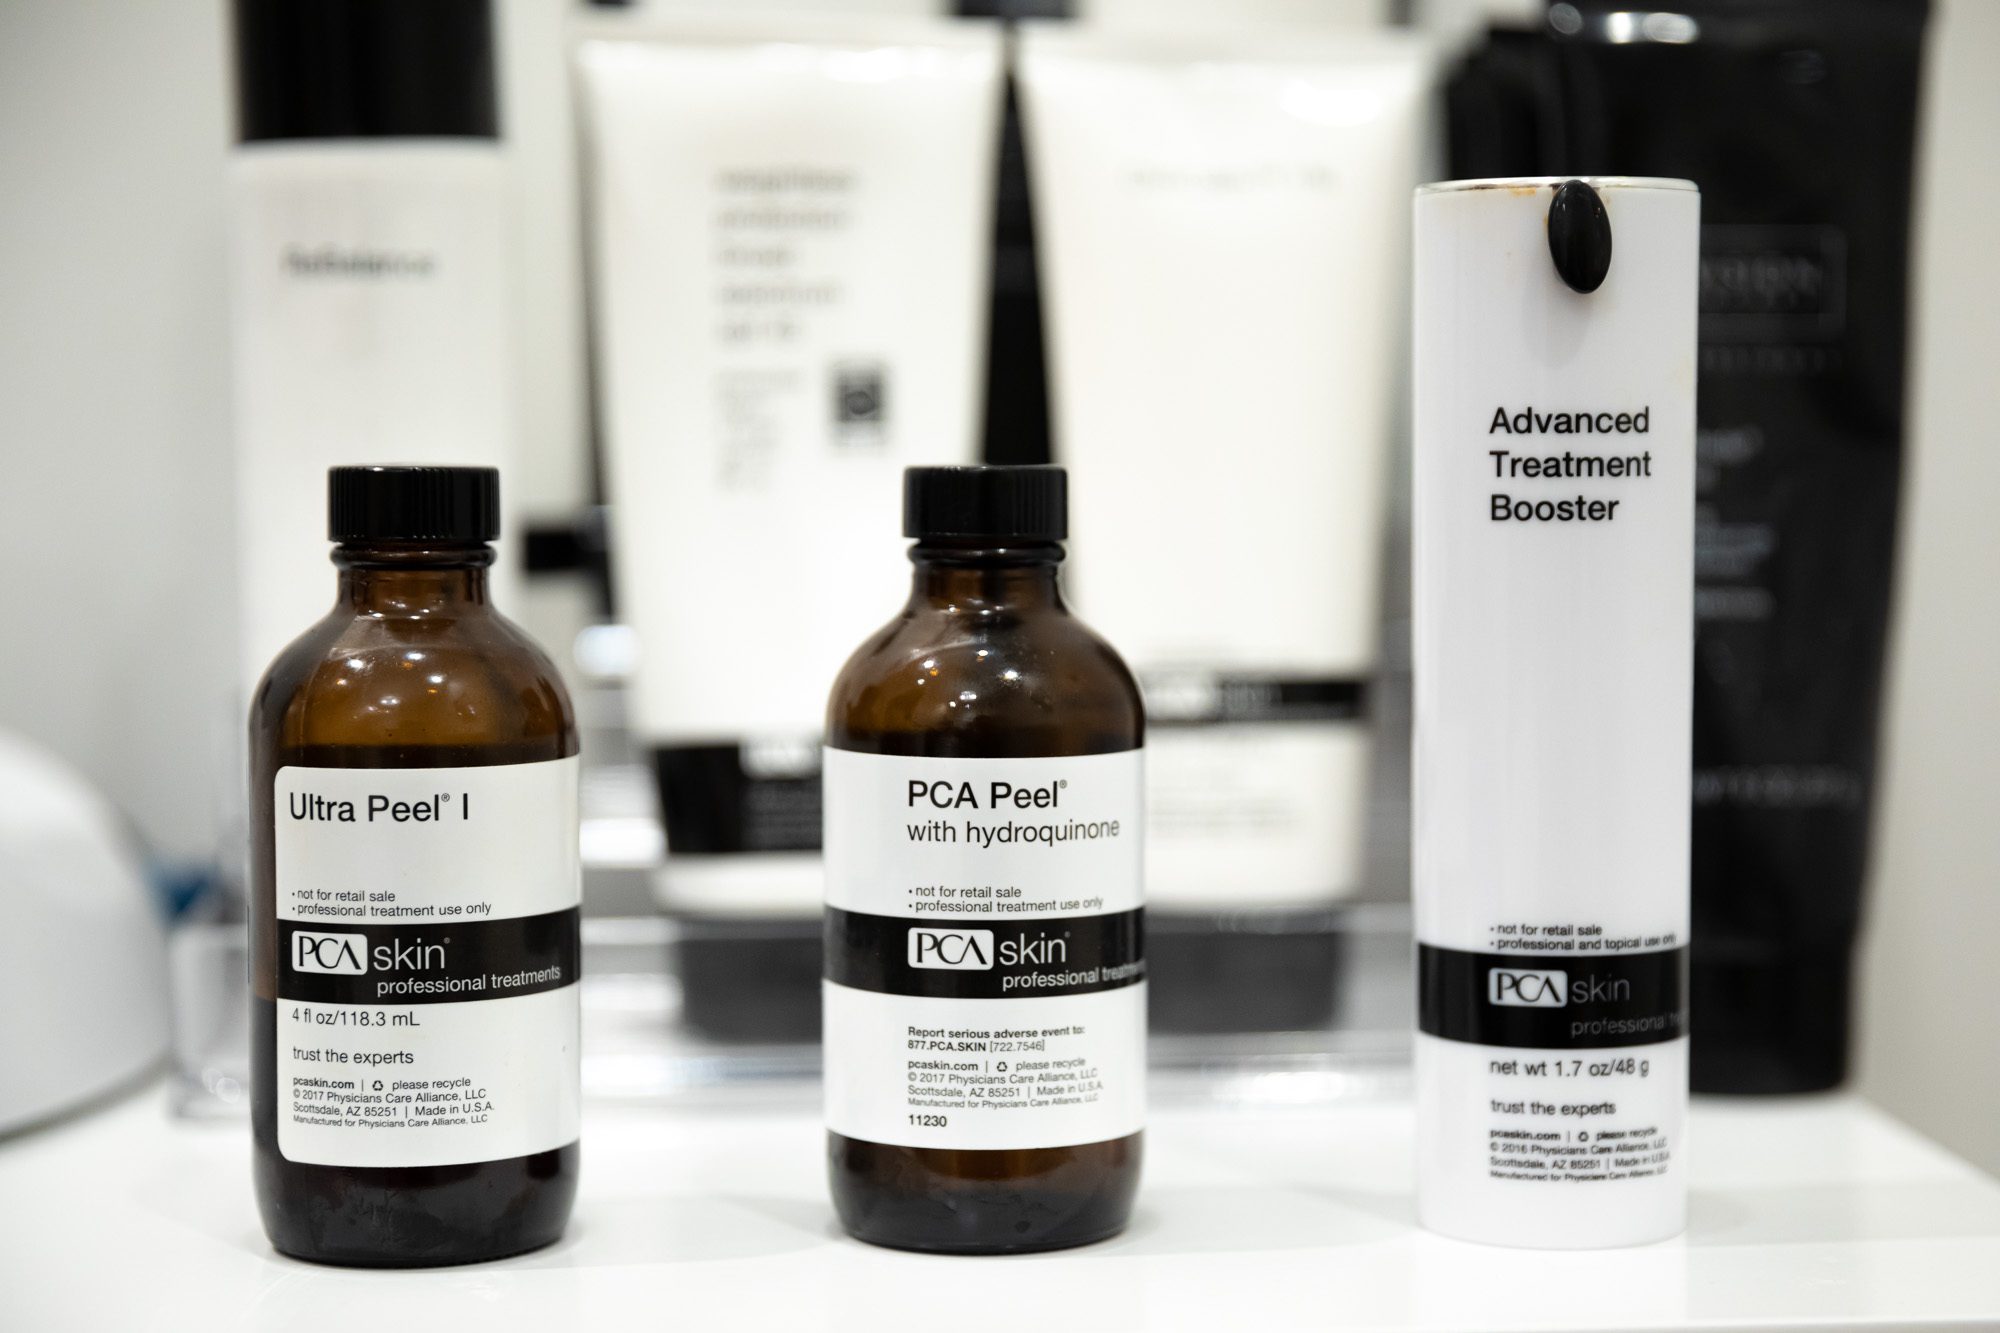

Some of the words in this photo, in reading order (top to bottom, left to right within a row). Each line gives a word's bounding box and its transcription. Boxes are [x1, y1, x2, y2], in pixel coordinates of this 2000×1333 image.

[1489, 406, 1650, 434] Advanced
[1489, 450, 1651, 478] Treatment
[1491, 494, 1619, 521] Booster
[908, 780, 978, 809] PCA
[290, 792, 355, 822] Ultra
[908, 820, 956, 842] with
[966, 819, 1120, 848] hydroquinone
[297, 889, 314, 901] not
[317, 889, 331, 901] for
[335, 890, 365, 902] retail
[370, 890, 396, 903] sale
[915, 886, 935, 897] not
[939, 886, 955, 897] for
[960, 886, 991, 898] retail
[996, 886, 1021, 898] sale
[297, 904, 366, 918] professional
[371, 904, 434, 917] treatment
[439, 904, 462, 916] use
[466, 902, 492, 916] only
[915, 900, 992, 913] professional
[997, 900, 1056, 913] treatment
[1060, 900, 1079, 910] use
[1083, 896, 1103, 911] only
[1497, 925, 1517, 935] not
[1521, 924, 1538, 935] for
[1542, 925, 1574, 936] retail
[1578, 925, 1602, 936] sale
[916, 932, 987, 965] PCA
[1497, 938, 1574, 951] professional
[1579, 938, 1601, 950] and
[1606, 936, 1641, 951] topical
[1645, 936, 1660, 947] use
[299, 936, 361, 970] PCA
[377, 974, 486, 997] professional
[492, 966, 560, 989] treatments
[1002, 967, 1099, 991] professional
[1497, 973, 1562, 1003] PCA
[1572, 974, 1630, 1004] skin
[292, 1008, 299, 1022] 4
[304, 1009, 311, 1023] fl
[316, 1010, 386, 1027] oz/118.3
[392, 1012, 420, 1026] mL
[1571, 1013, 1666, 1039] professional
[908, 1027, 944, 1039] Report
[948, 1028, 990, 1039] serious
[994, 1028, 1038, 1039] adverse
[1041, 1026, 1069, 1037] event
[908, 1040, 986, 1052] 877.PCA.SKIN
[990, 1039, 1044, 1052] [722.7546]
[293, 1046, 321, 1062] trust
[326, 1048, 348, 1064] the
[354, 1050, 414, 1067] experts
[908, 1060, 978, 1070] pcaskin.com
[1016, 1061, 1049, 1072] please
[1053, 1058, 1085, 1069] recycle
[1490, 1060, 1518, 1075] net
[1524, 1061, 1546, 1076] wt
[1555, 1061, 1582, 1076] 1.7
[1590, 1058, 1634, 1076] oz/48
[1641, 1060, 1649, 1077] g
[293, 1077, 354, 1090] pcaskin.com
[392, 1080, 428, 1091] please
[432, 1077, 471, 1090] recycle
[920, 1073, 944, 1083] 2017
[949, 1074, 1006, 1086] Physicians
[1009, 1074, 1034, 1083] Care
[1080, 1068, 1098, 1079] LLC
[303, 1090, 324, 1100] 2017
[327, 1092, 382, 1104] Physicians
[385, 1093, 412, 1103] Care
[415, 1092, 462, 1102] Alliance,
[465, 1088, 486, 1099] LLC
[908, 1085, 965, 1097] Scottsdale,
[969, 1088, 984, 1097] AZ
[988, 1087, 1020, 1097] 85251
[1037, 1086, 1065, 1096] Made
[1068, 1084, 1075, 1093] in
[293, 1101, 342, 1116] Scottsdale,
[346, 1106, 360, 1116] AZ
[364, 1106, 396, 1116] 85251
[415, 1106, 446, 1116] Made
[450, 1105, 458, 1113] in
[908, 1098, 964, 1108] Manufactured
[982, 1101, 1028, 1110] Physicians
[1030, 1099, 1049, 1107] Care
[1491, 1100, 1524, 1114] trust
[1531, 1102, 1555, 1115] the
[1561, 1102, 1616, 1118] experts
[293, 1114, 342, 1126] Manufactured
[359, 1119, 405, 1129] Physicians
[408, 1119, 429, 1127] Care
[471, 1114, 487, 1123] LLC
[908, 1114, 947, 1127] 11230
[1531, 1145, 1587, 1157] Physicians
